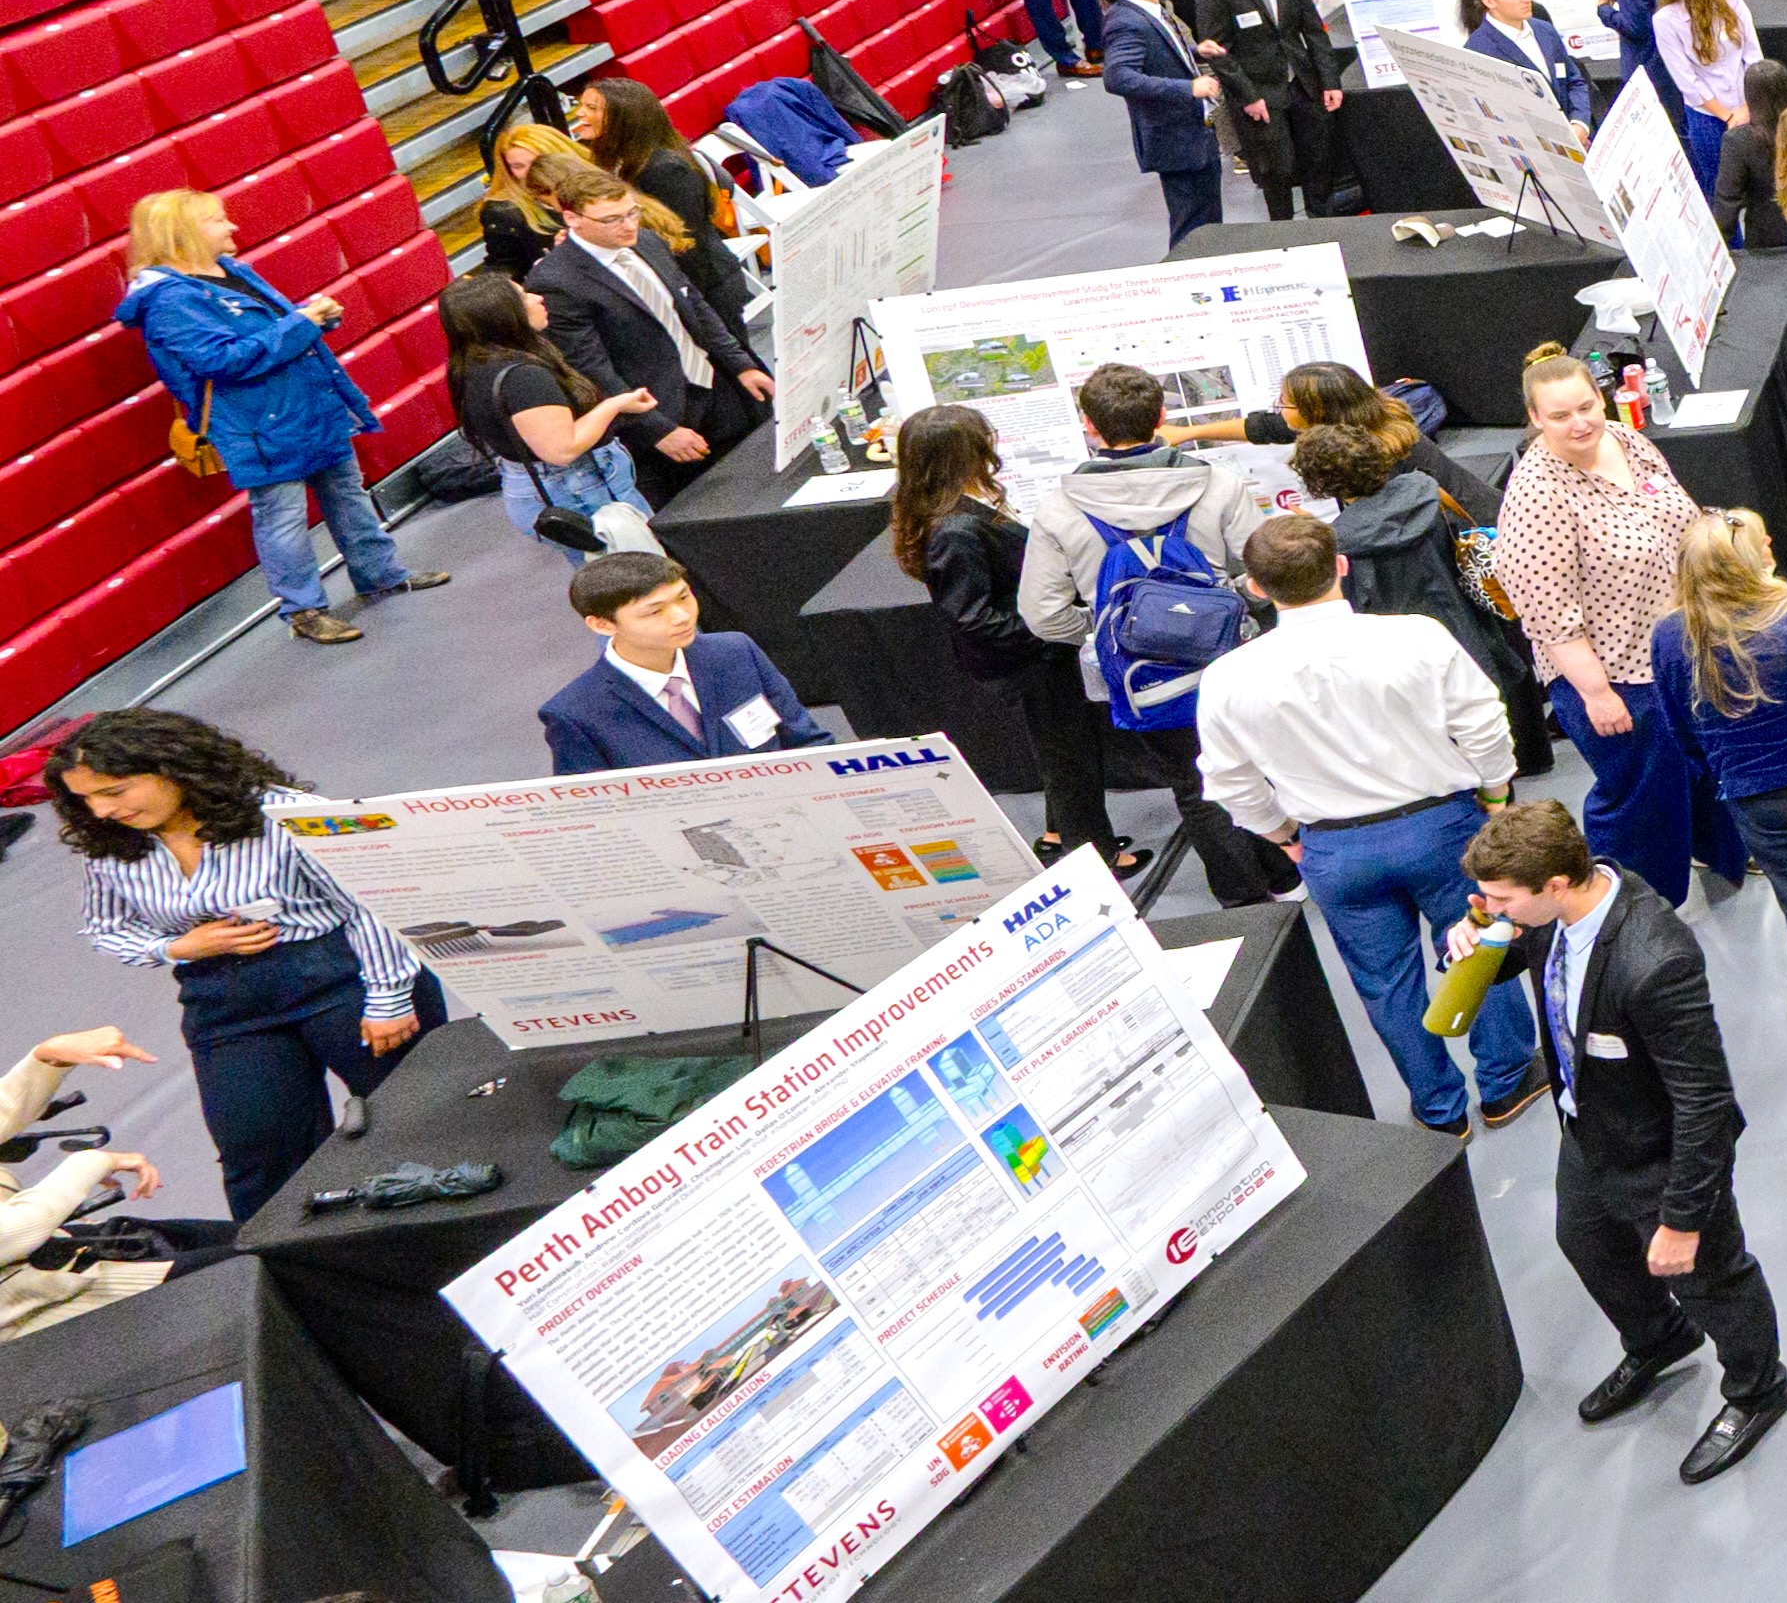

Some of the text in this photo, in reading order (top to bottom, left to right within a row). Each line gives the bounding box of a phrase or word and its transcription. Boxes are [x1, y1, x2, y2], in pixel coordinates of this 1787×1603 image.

[636, 762, 812, 789] Restoration
[829, 749, 949, 774] HALL
[402, 782, 630, 814] Hoboken Ferry
[1002, 884, 1071, 934] HALL
[1023, 912, 1072, 952] ADA
[970, 948, 1067, 1020] CODES AND STANDARDS
[512, 1009, 635, 1032] STEVENS
[745, 942, 992, 1119] Station Improvements
[1012, 999, 1120, 1084] SITE PLAN & GRADING PLAN
[753, 1034, 947, 1178] PEDESTRIAN BRIDGE & ELEVATOR FRAMING
[496, 1116, 747, 1296] Perth Amboy Train
[1195, 1160, 1270, 1228] innovation
[537, 1256, 641, 1336] PROJECT OVERVIEW
[877, 1272, 962, 1345] PROJECT SCHEDULE
[1043, 1332, 1082, 1369] ENVISION
[1058, 1344, 1089, 1372] RATING
[654, 1371, 772, 1471] LOADING CALCULATIONS
[707, 1456, 794, 1533] COST ESTIMATION
[927, 1456, 943, 1472] UN
[930, 1468, 950, 1488] SDG
[771, 1499, 896, 1603] TEVENS
